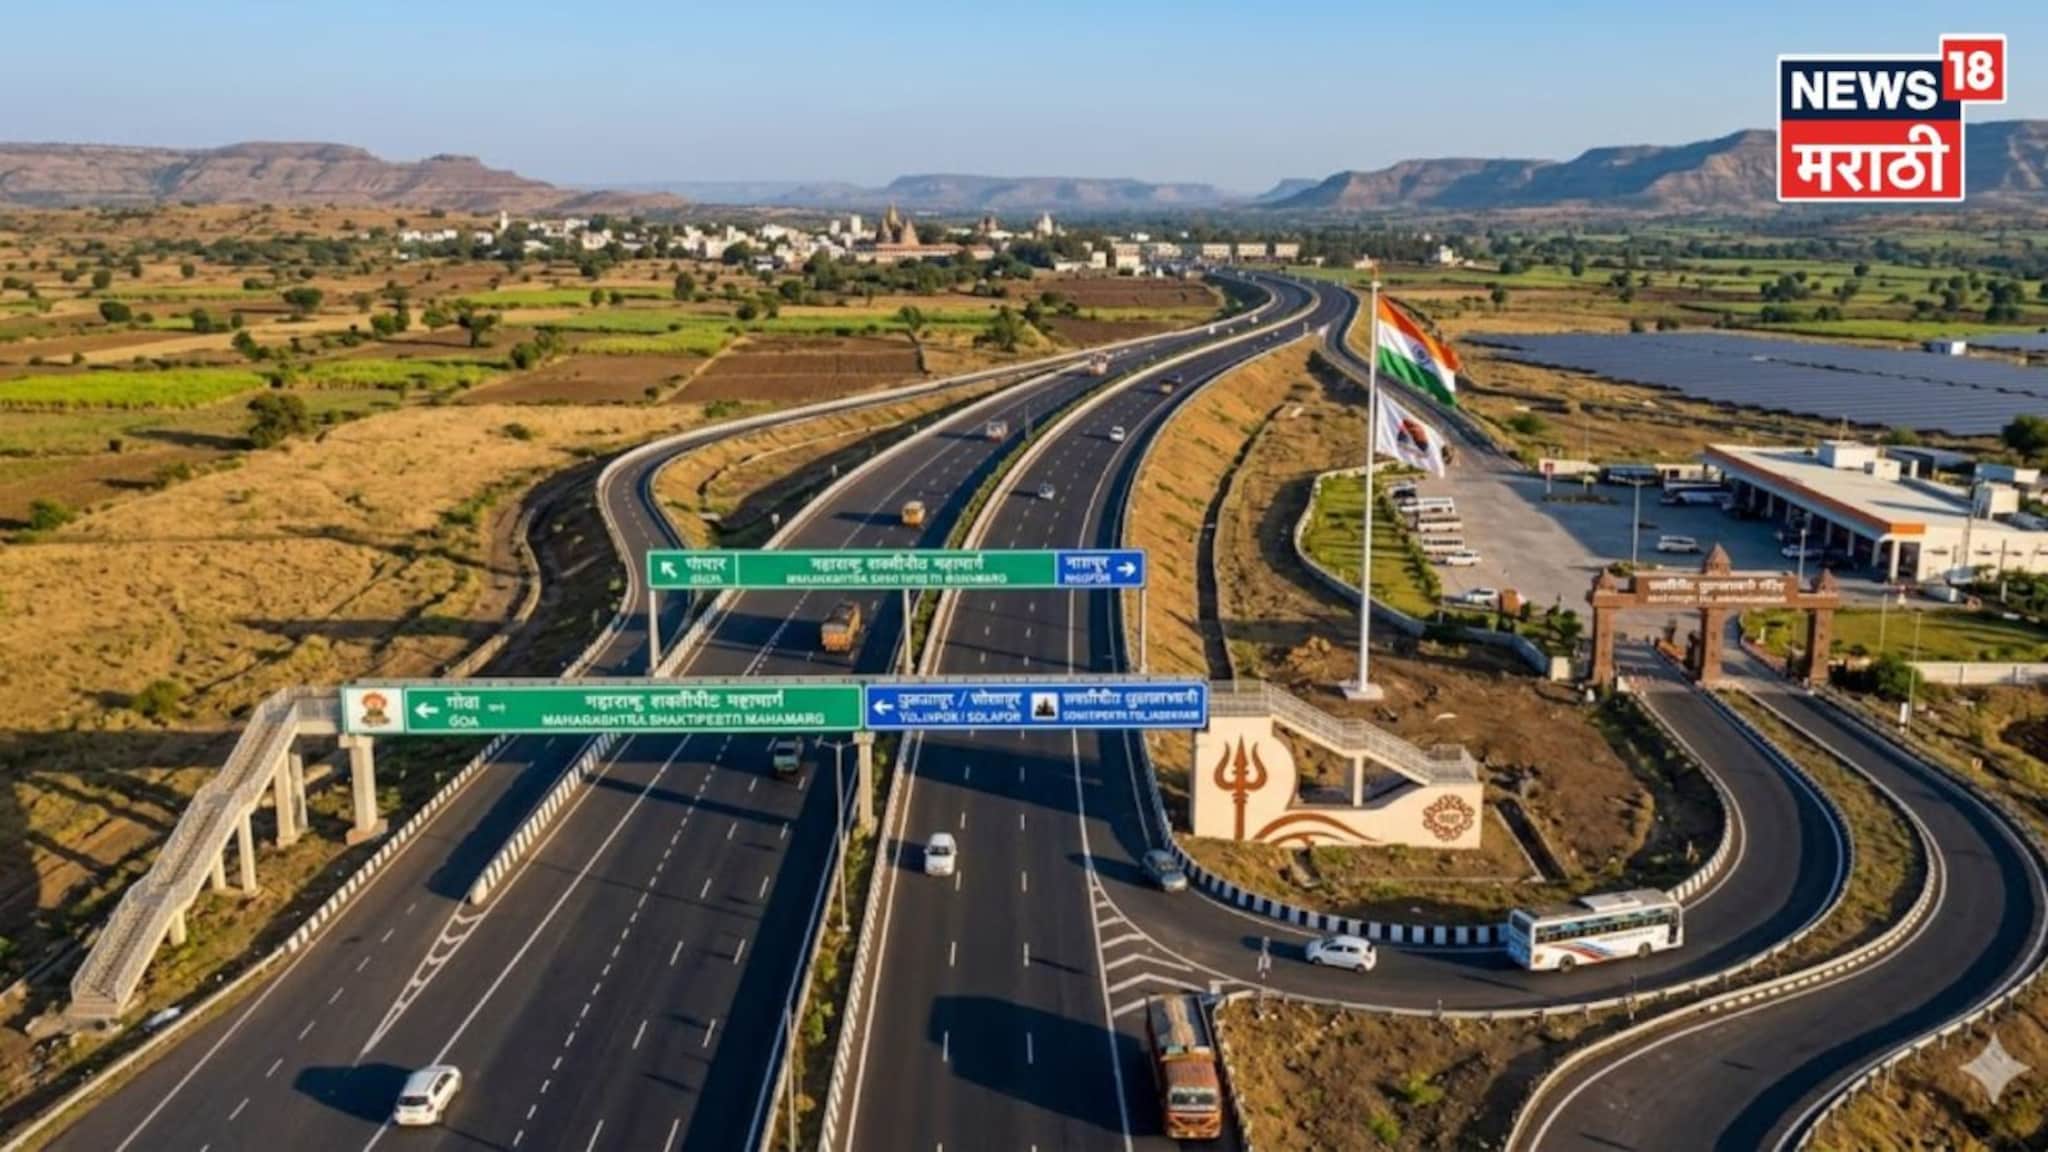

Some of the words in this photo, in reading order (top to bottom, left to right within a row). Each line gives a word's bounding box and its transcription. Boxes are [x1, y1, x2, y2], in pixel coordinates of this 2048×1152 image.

[446, 691, 480, 709] गोवा
[448, 714, 479, 728] GOA
[744, 714, 824, 726] MAHAMARG
